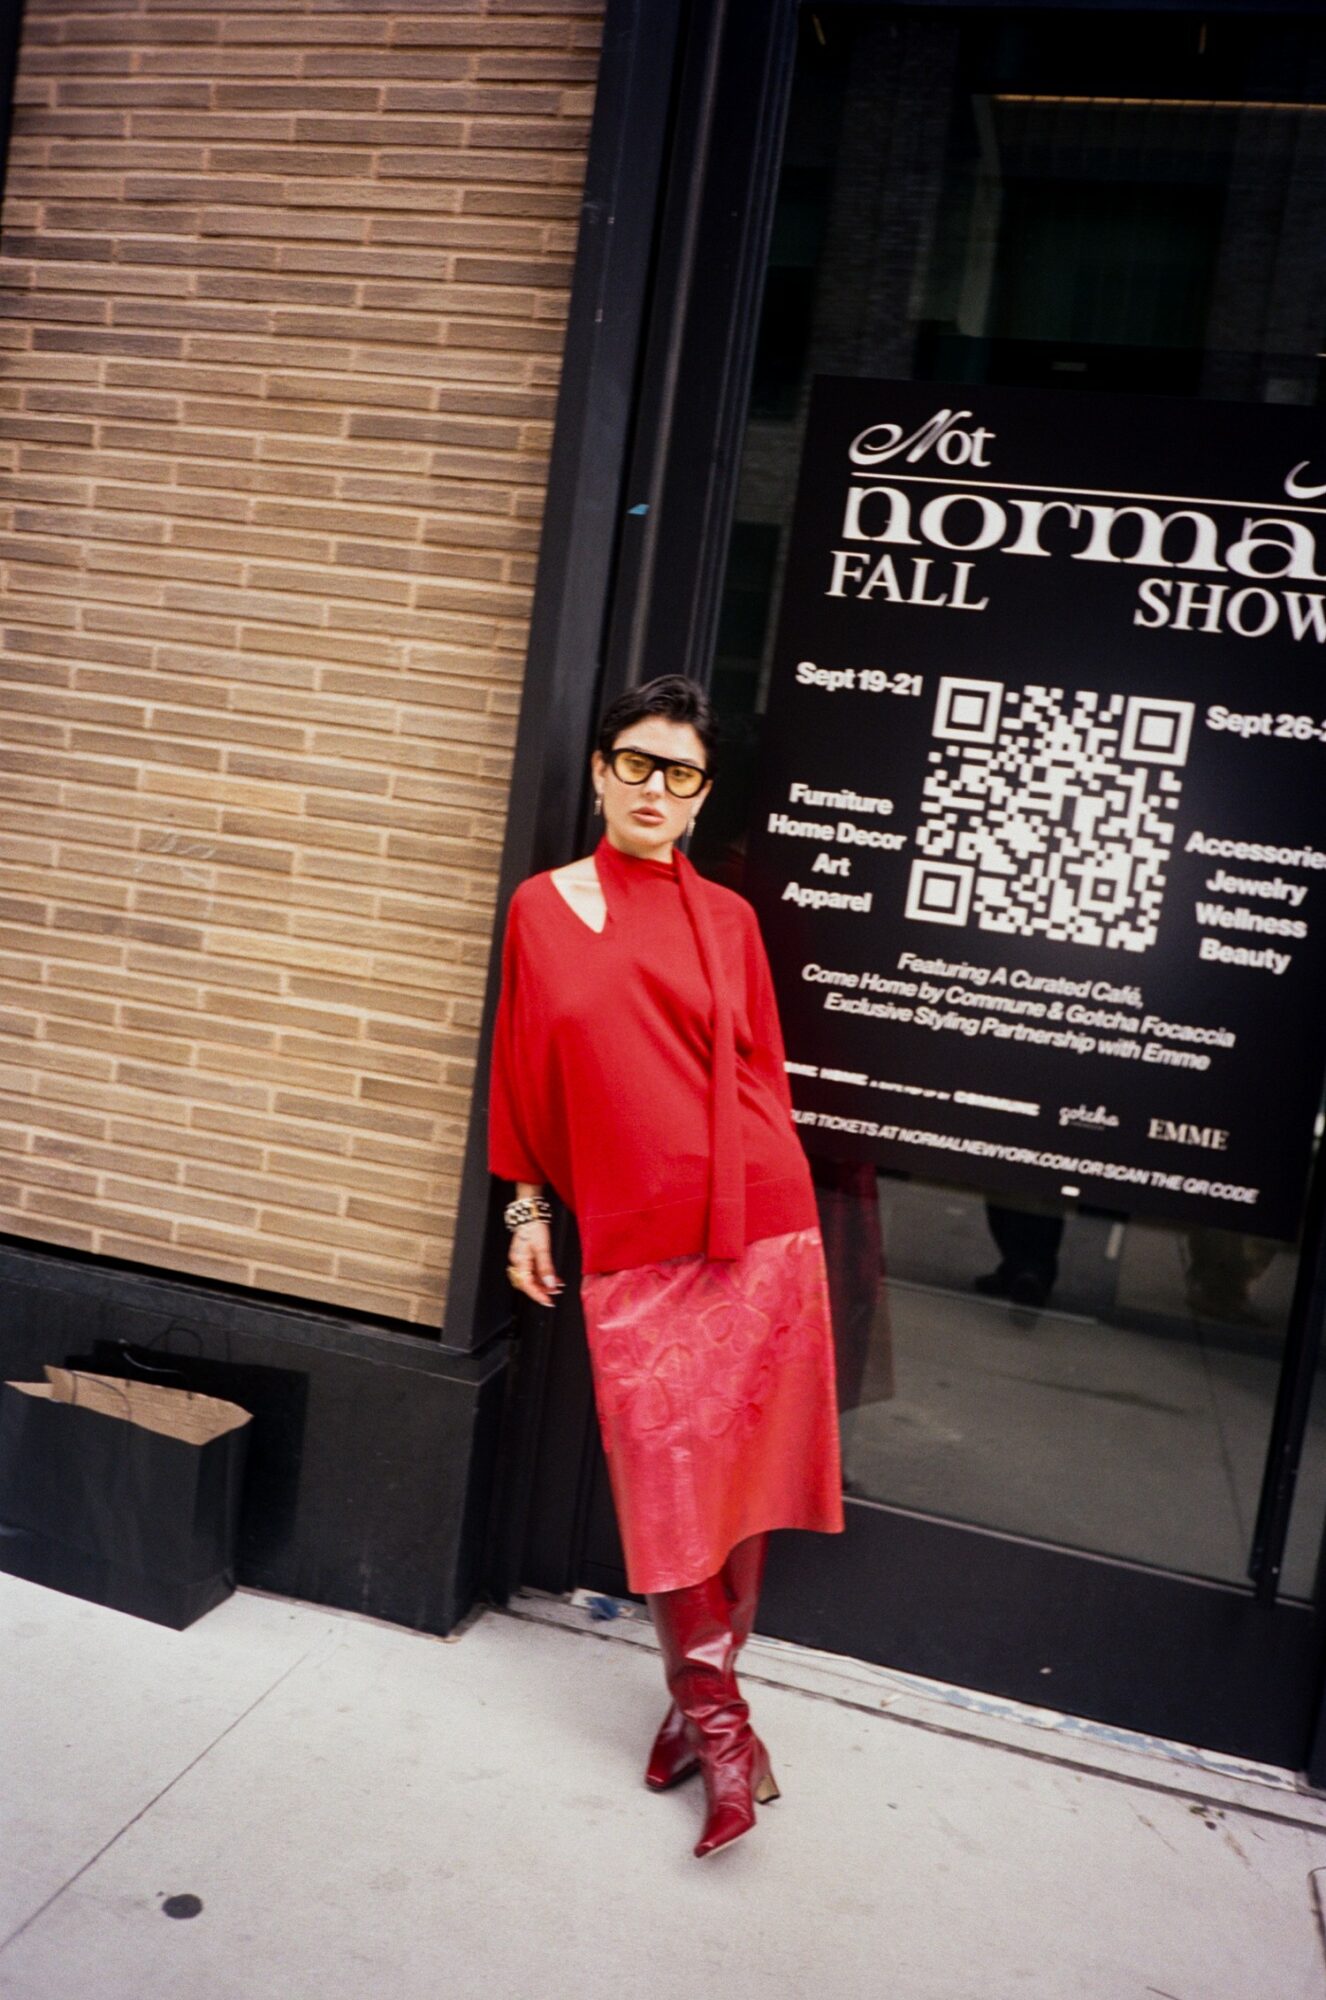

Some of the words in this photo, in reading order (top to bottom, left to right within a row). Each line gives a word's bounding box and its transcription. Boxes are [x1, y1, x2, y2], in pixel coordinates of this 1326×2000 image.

[847, 408, 996, 467] Not
[842, 485, 1326, 582] norma
[825, 550, 990, 611] FALL
[1133, 577, 1326, 644] SHOW
[795, 661, 854, 692] Sept
[856, 669, 924, 697] 19-21
[1204, 705, 1273, 738] Sept
[788, 782, 894, 816] Furniture
[767, 813, 835, 841] Home
[836, 821, 907, 851] Decor
[1184, 831, 1326, 870] Accessorie
[811, 852, 851, 877] Art
[782, 881, 873, 913] Apparel
[1205, 869, 1309, 907] Jewelry
[1195, 901, 1308, 939] Wellness
[1199, 936, 1292, 975] Beauty
[897, 952, 991, 986] Featuring
[989, 966, 1008, 986] A
[1009, 969, 1093, 998] Curated
[1091, 981, 1144, 1009] Café,
[801, 963, 860, 988] Come
[858, 972, 919, 997] Home
[918, 981, 946, 1004] by
[945, 986, 1047, 1018] Commune
[1046, 1001, 1064, 1021] &
[1065, 1004, 1140, 1033] Gotcha
[1140, 1015, 1236, 1048] Focaccia
[824, 992, 914, 1022] Exclusive
[913, 1006, 981, 1037] Styling
[980, 1017, 1097, 1054] Partnership
[1098, 1038, 1142, 1060] with
[1141, 1042, 1212, 1071] Emme
[1147, 1117, 1230, 1150] EMME
[816, 1113, 880, 1138] TICKETS
[877, 1124, 900, 1140] AT
[1077, 1158, 1103, 1176] OR
[1101, 1163, 1150, 1185] SCAN
[1149, 1171, 1184, 1191] THE
[1182, 1177, 1209, 1195] QR
[1208, 1182, 1260, 1205] CODE
